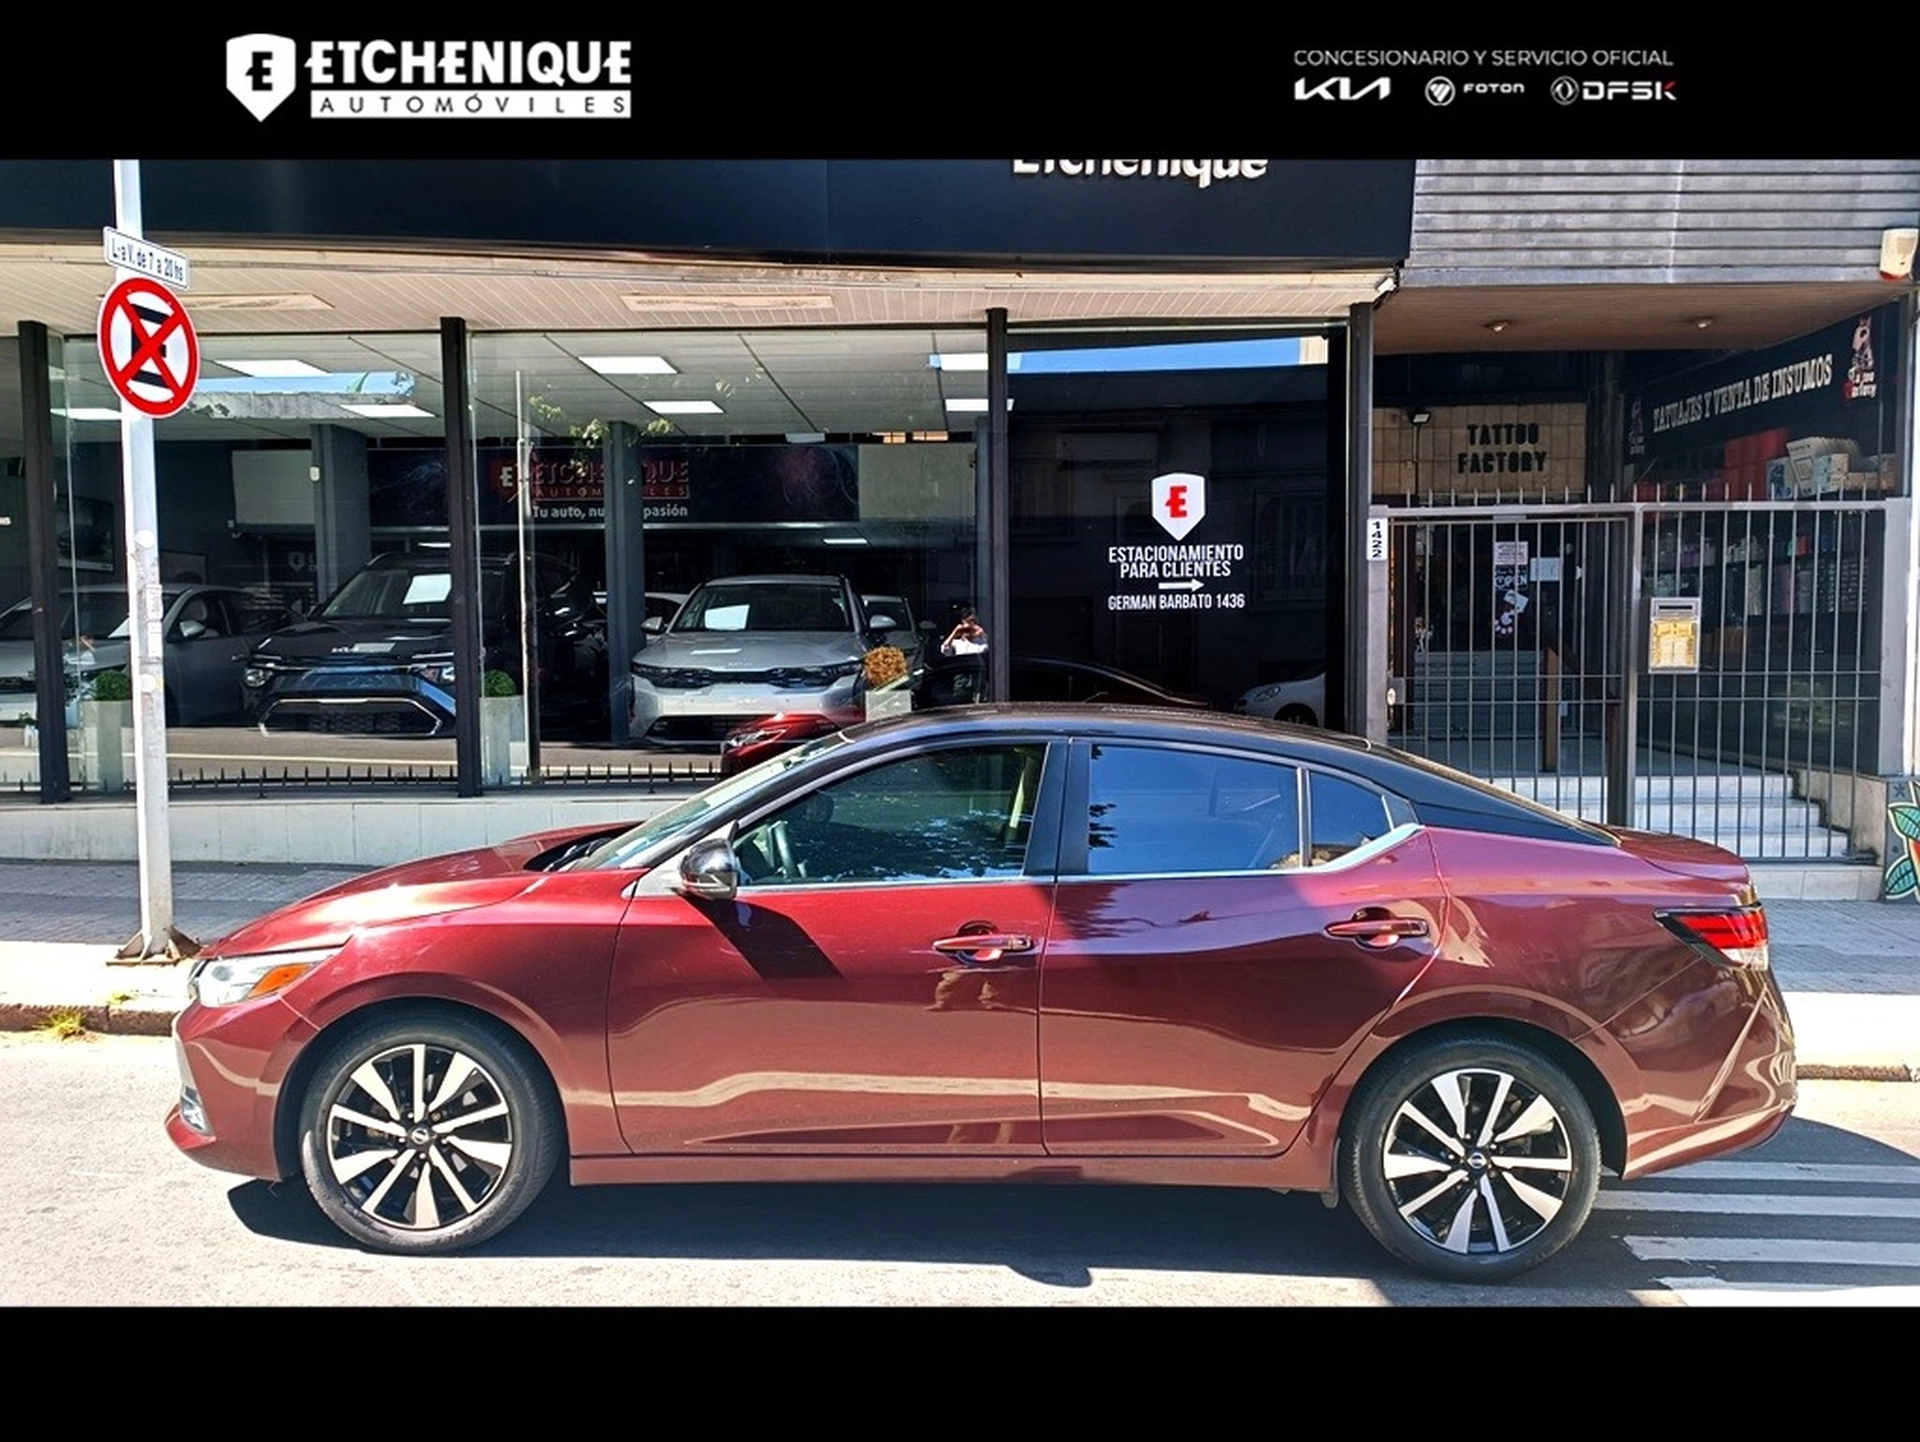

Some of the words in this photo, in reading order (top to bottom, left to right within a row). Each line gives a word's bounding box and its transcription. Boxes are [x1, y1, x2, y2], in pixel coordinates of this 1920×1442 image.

[137, 247, 146, 269] de
[148, 251, 154, 271] 7
[157, 258, 162, 274] a
[164, 257, 173, 278] 20
[174, 260, 184, 282] hs
[1652, 394, 1703, 433] TATUAJES
[1704, 390, 1713, 419] Y
[1713, 378, 1752, 416] VENTA
[1753, 372, 1770, 404] DE
[1771, 353, 1834, 399] INSUMOS
[1467, 422, 1540, 446] TATTOO
[1457, 451, 1548, 474] FACTORY
[533, 506, 549, 519] Tu
[551, 505, 586, 520] auto,
[643, 503, 689, 520] pasión
[1372, 521, 1382, 558] 1422
[1108, 544, 1244, 563] ESTACIONAMIENTO
[1120, 562, 1159, 578] PARA
[1162, 560, 1232, 578] CLIENTES
[1107, 595, 1157, 610] GERMAN
[1159, 593, 1212, 609] BARBATO
[1216, 593, 1246, 609] 1436
